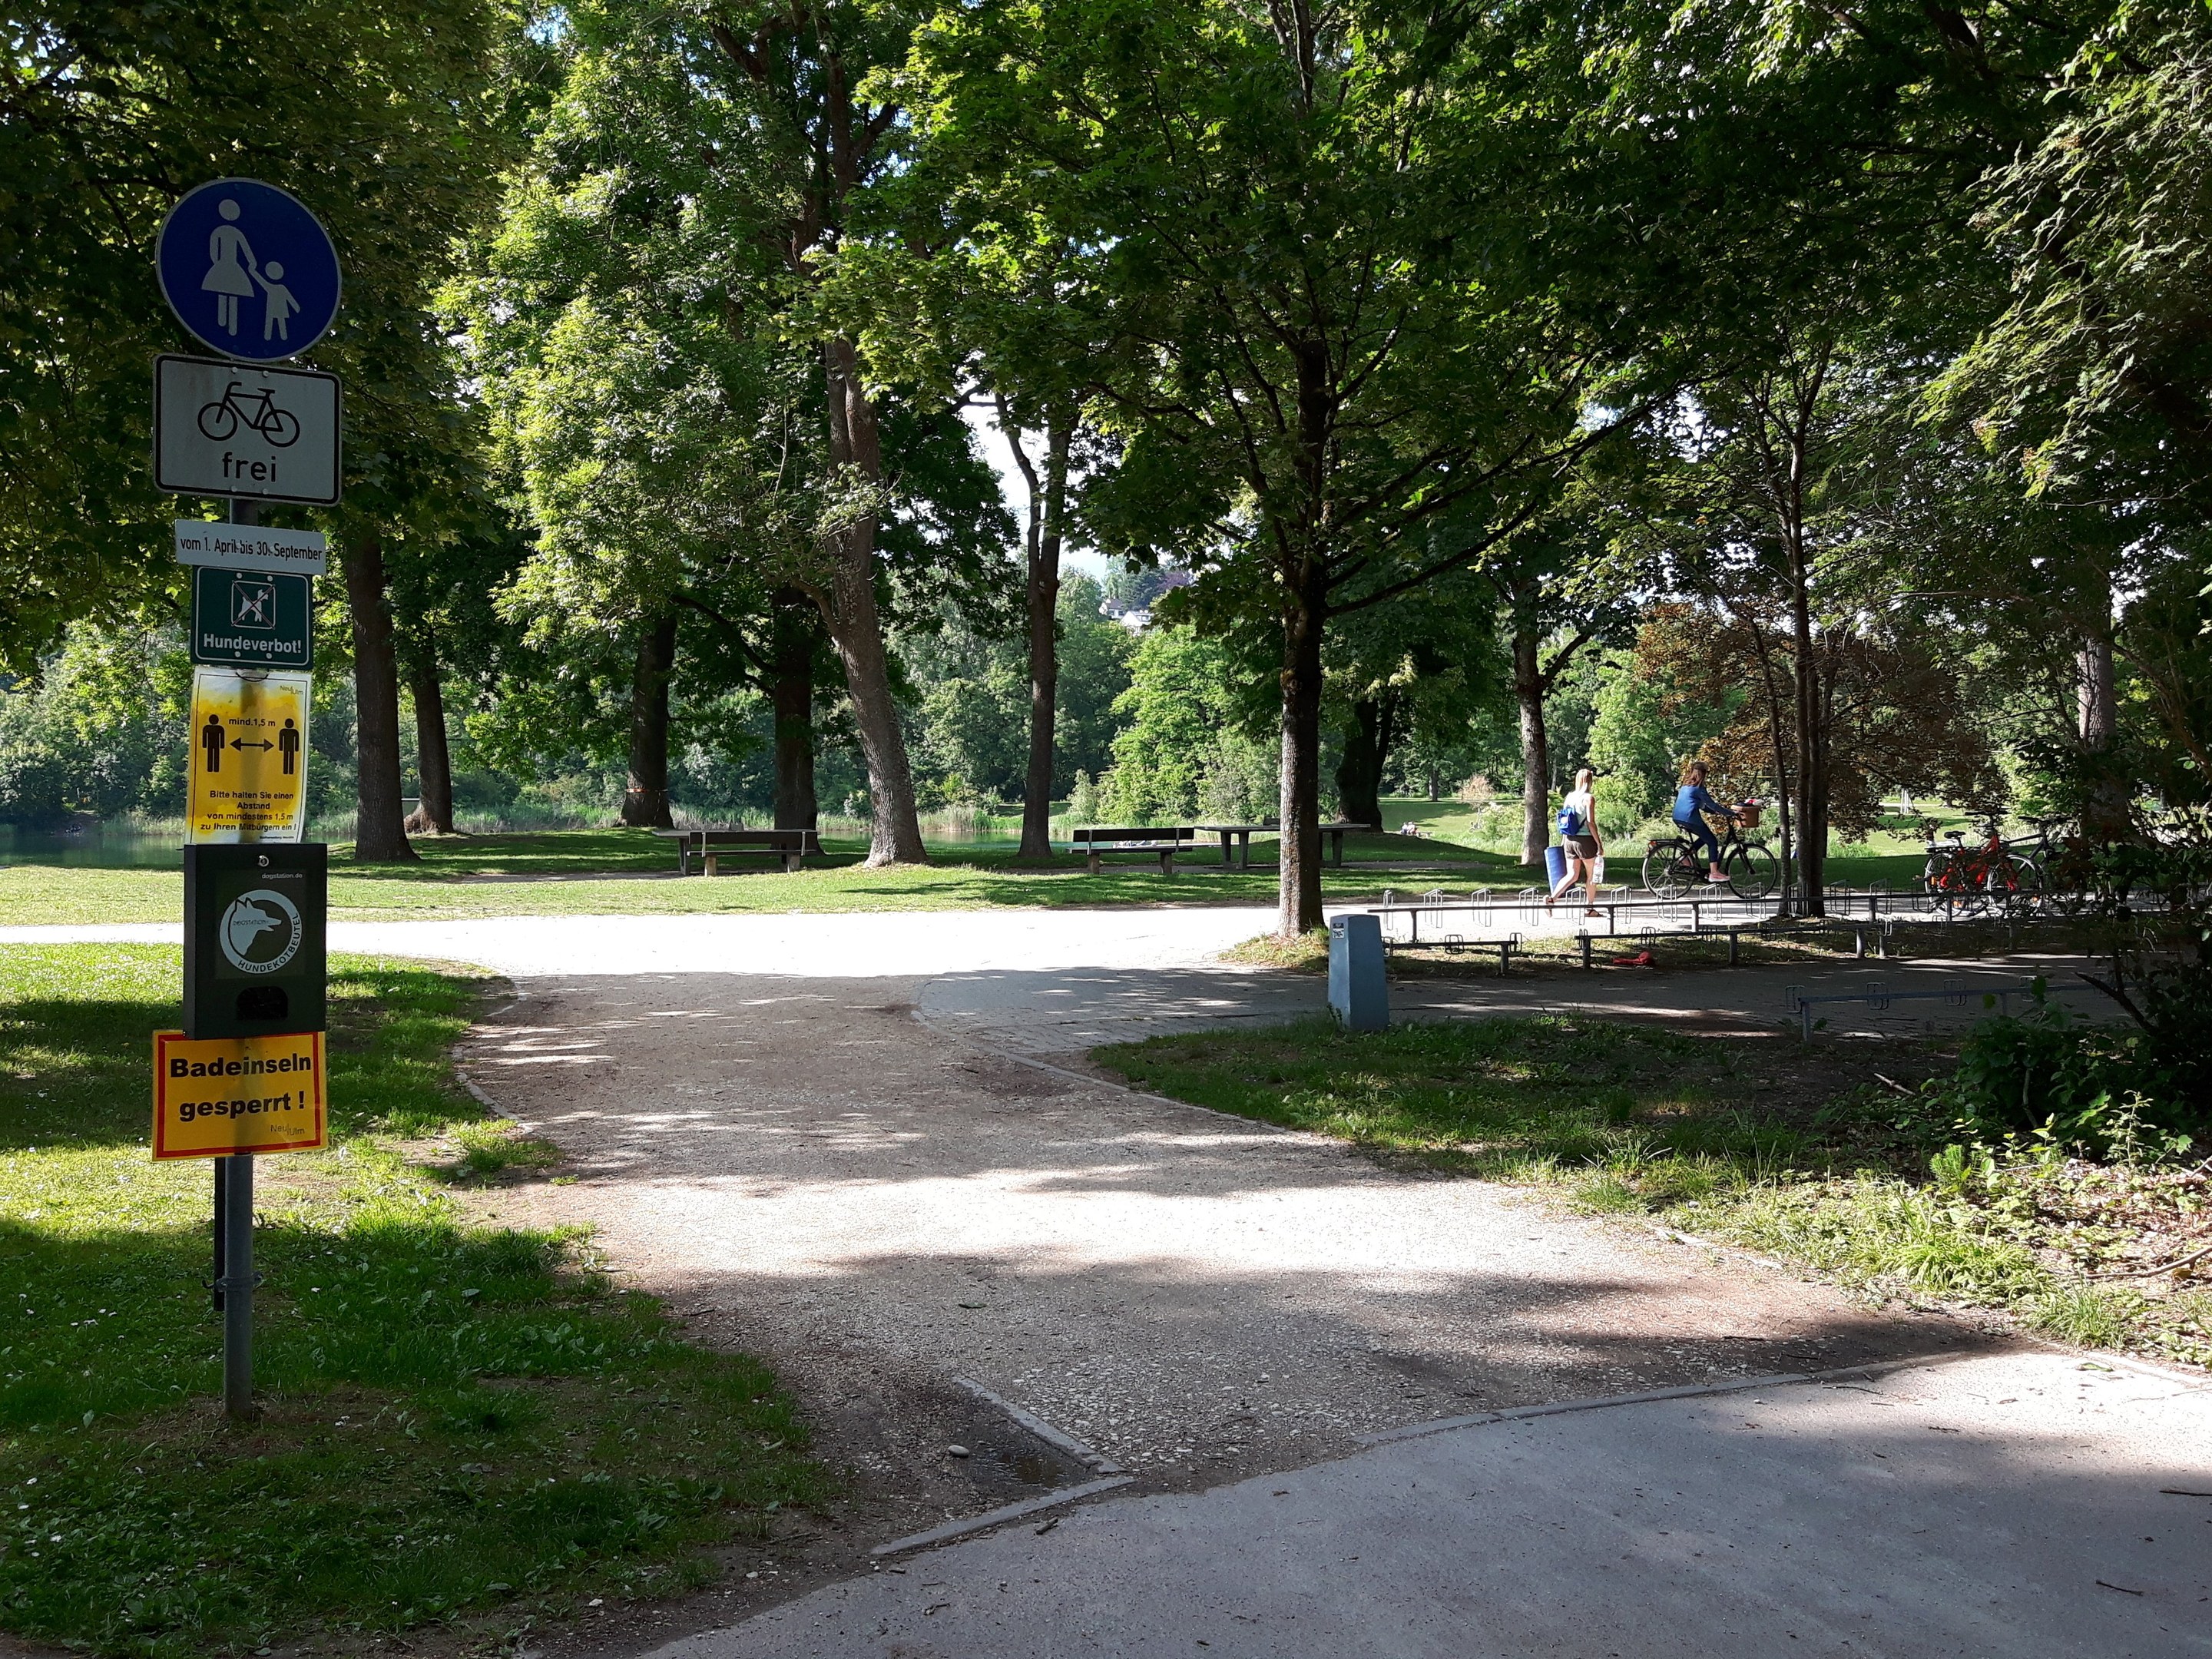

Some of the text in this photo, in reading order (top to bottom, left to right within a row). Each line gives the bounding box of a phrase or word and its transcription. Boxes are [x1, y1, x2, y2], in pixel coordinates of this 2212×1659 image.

[222, 451, 276, 482] frei
[180, 537, 323, 561] vom 1. April bis 30. September
[204, 633, 302, 654] Hundeverbot!
[210, 790, 230, 799] Bitte
[232, 791, 257, 800] halten
[260, 791, 271, 800] Sie
[226, 812, 273, 820] mindestens
[275, 813, 285, 821] 1,5
[238, 823, 280, 833] Mitbürgern
[237, 912, 302, 972] HUNDEKOTBEUTEL
[171, 1053, 311, 1078] Badeinseln
[179, 1092, 291, 1122] gesperrt
